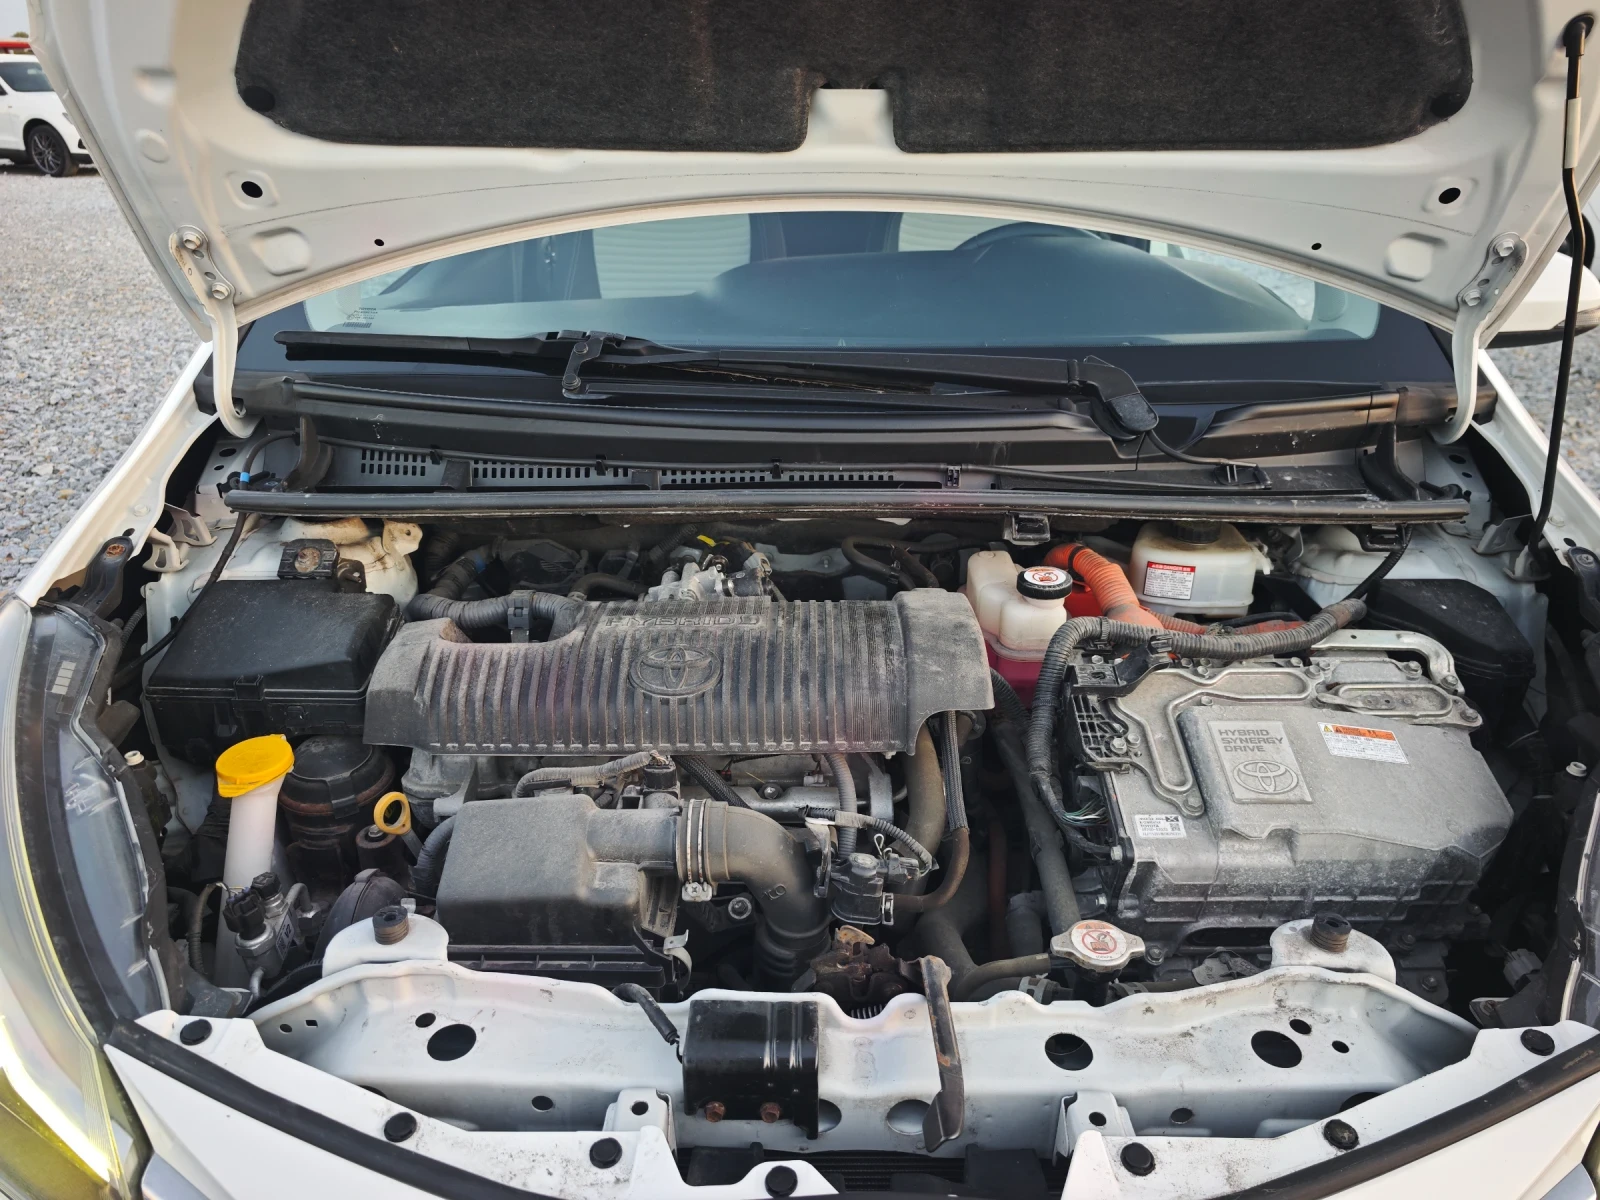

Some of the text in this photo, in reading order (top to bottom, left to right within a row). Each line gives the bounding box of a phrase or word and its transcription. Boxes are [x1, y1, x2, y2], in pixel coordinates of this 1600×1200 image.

[605, 615, 736, 627] HYBRID
[1218, 729, 1269, 737] HYBRID
[1220, 737, 1283, 745] SYNERGY
